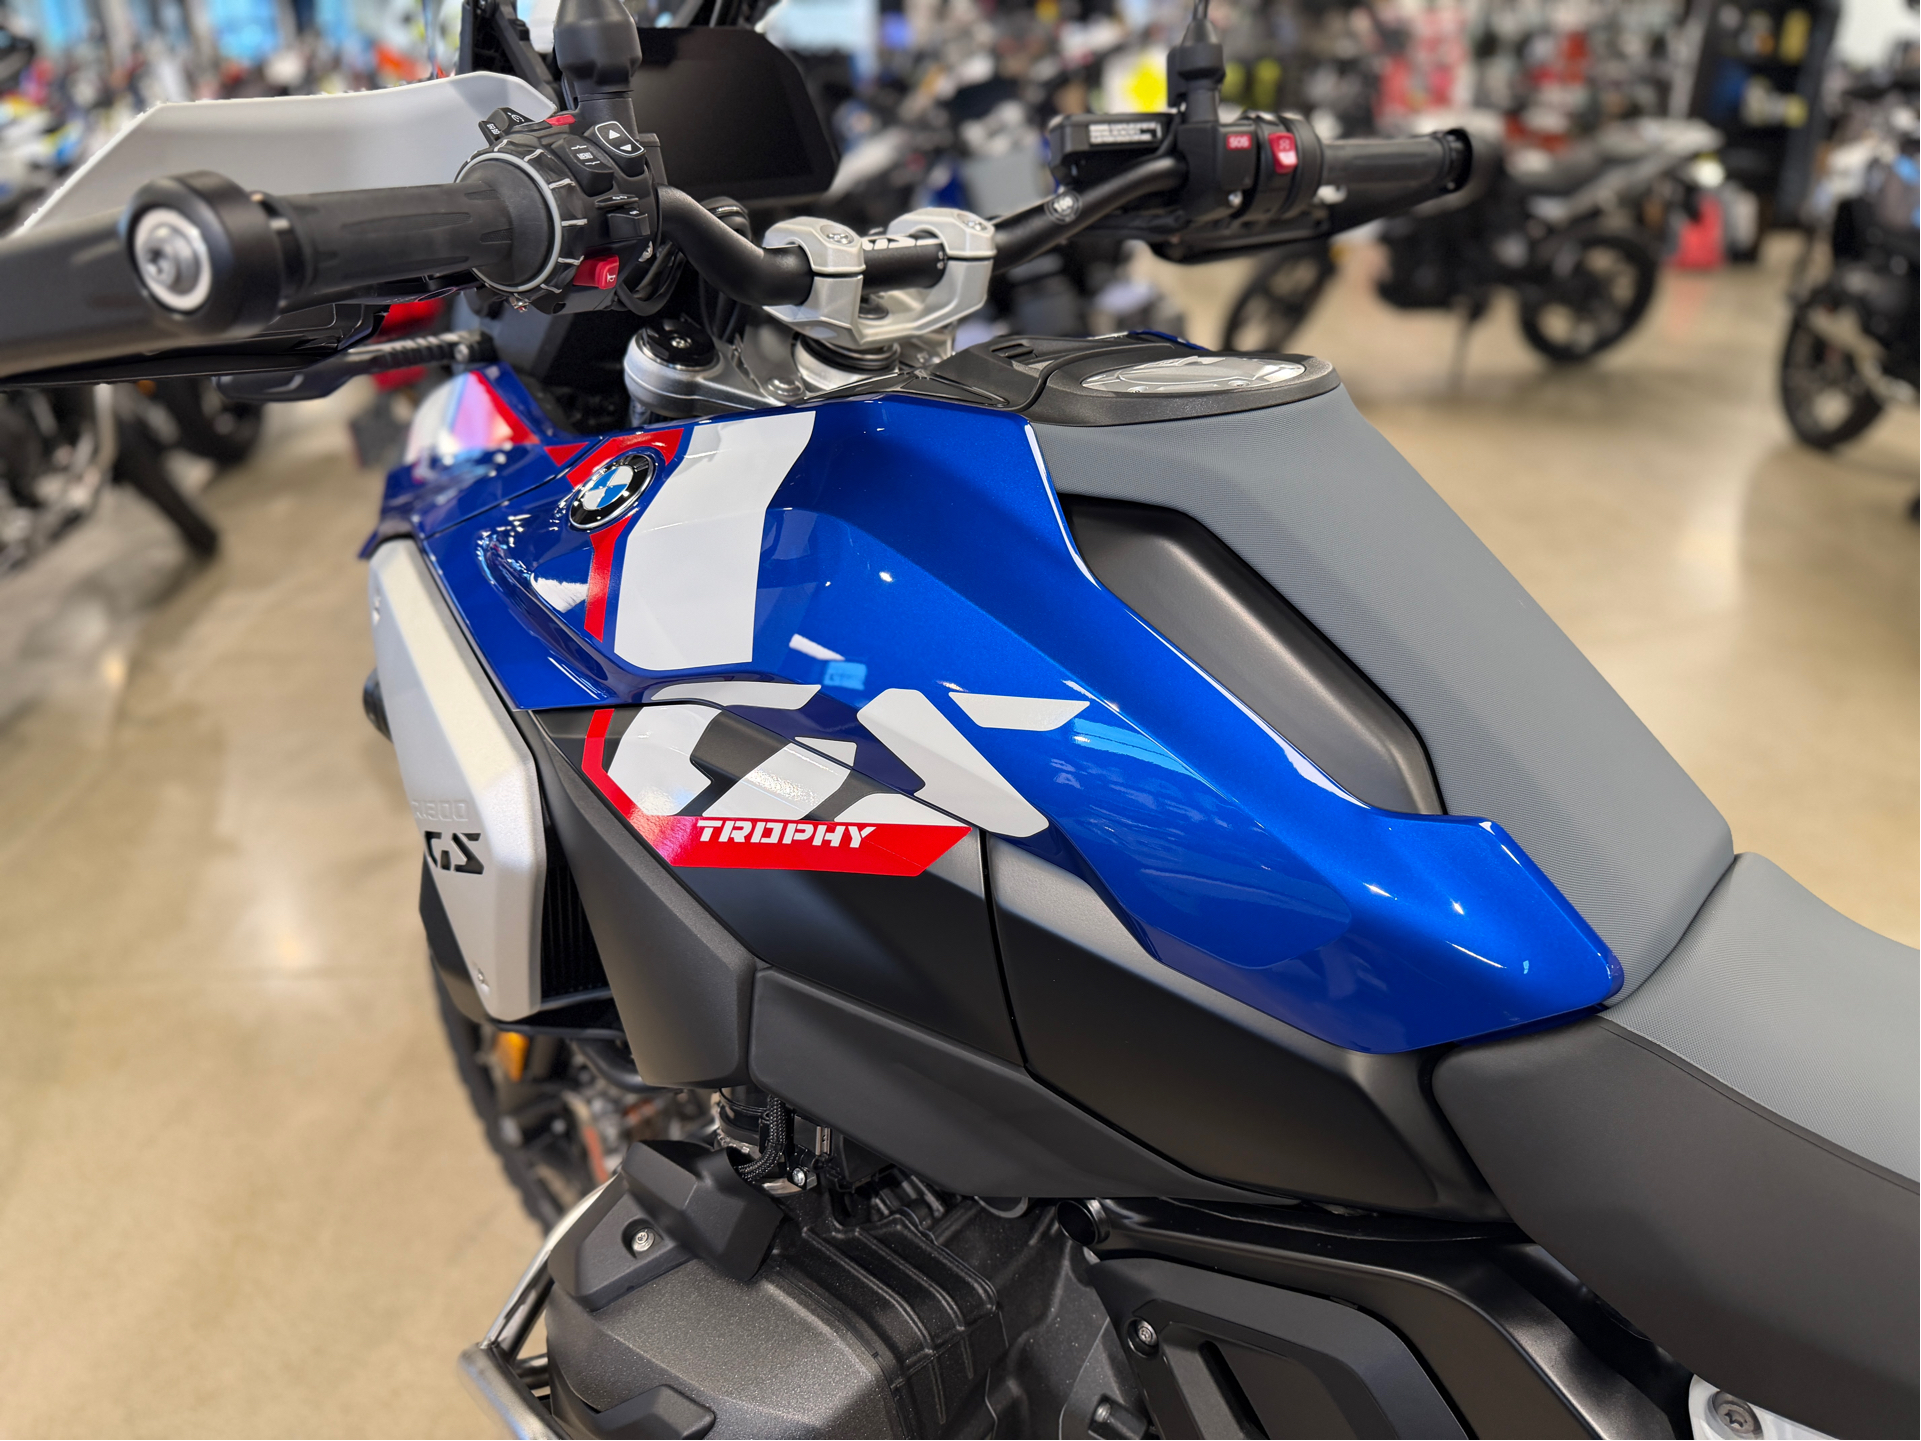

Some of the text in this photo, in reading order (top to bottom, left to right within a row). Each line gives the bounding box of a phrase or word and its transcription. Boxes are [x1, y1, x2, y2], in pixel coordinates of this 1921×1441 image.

[576, 151, 594, 161] MENU
[1228, 136, 1249, 148] SOS
[607, 681, 1090, 838] GS
[696, 819, 877, 848] TROPHY
[424, 831, 485, 875] GS
